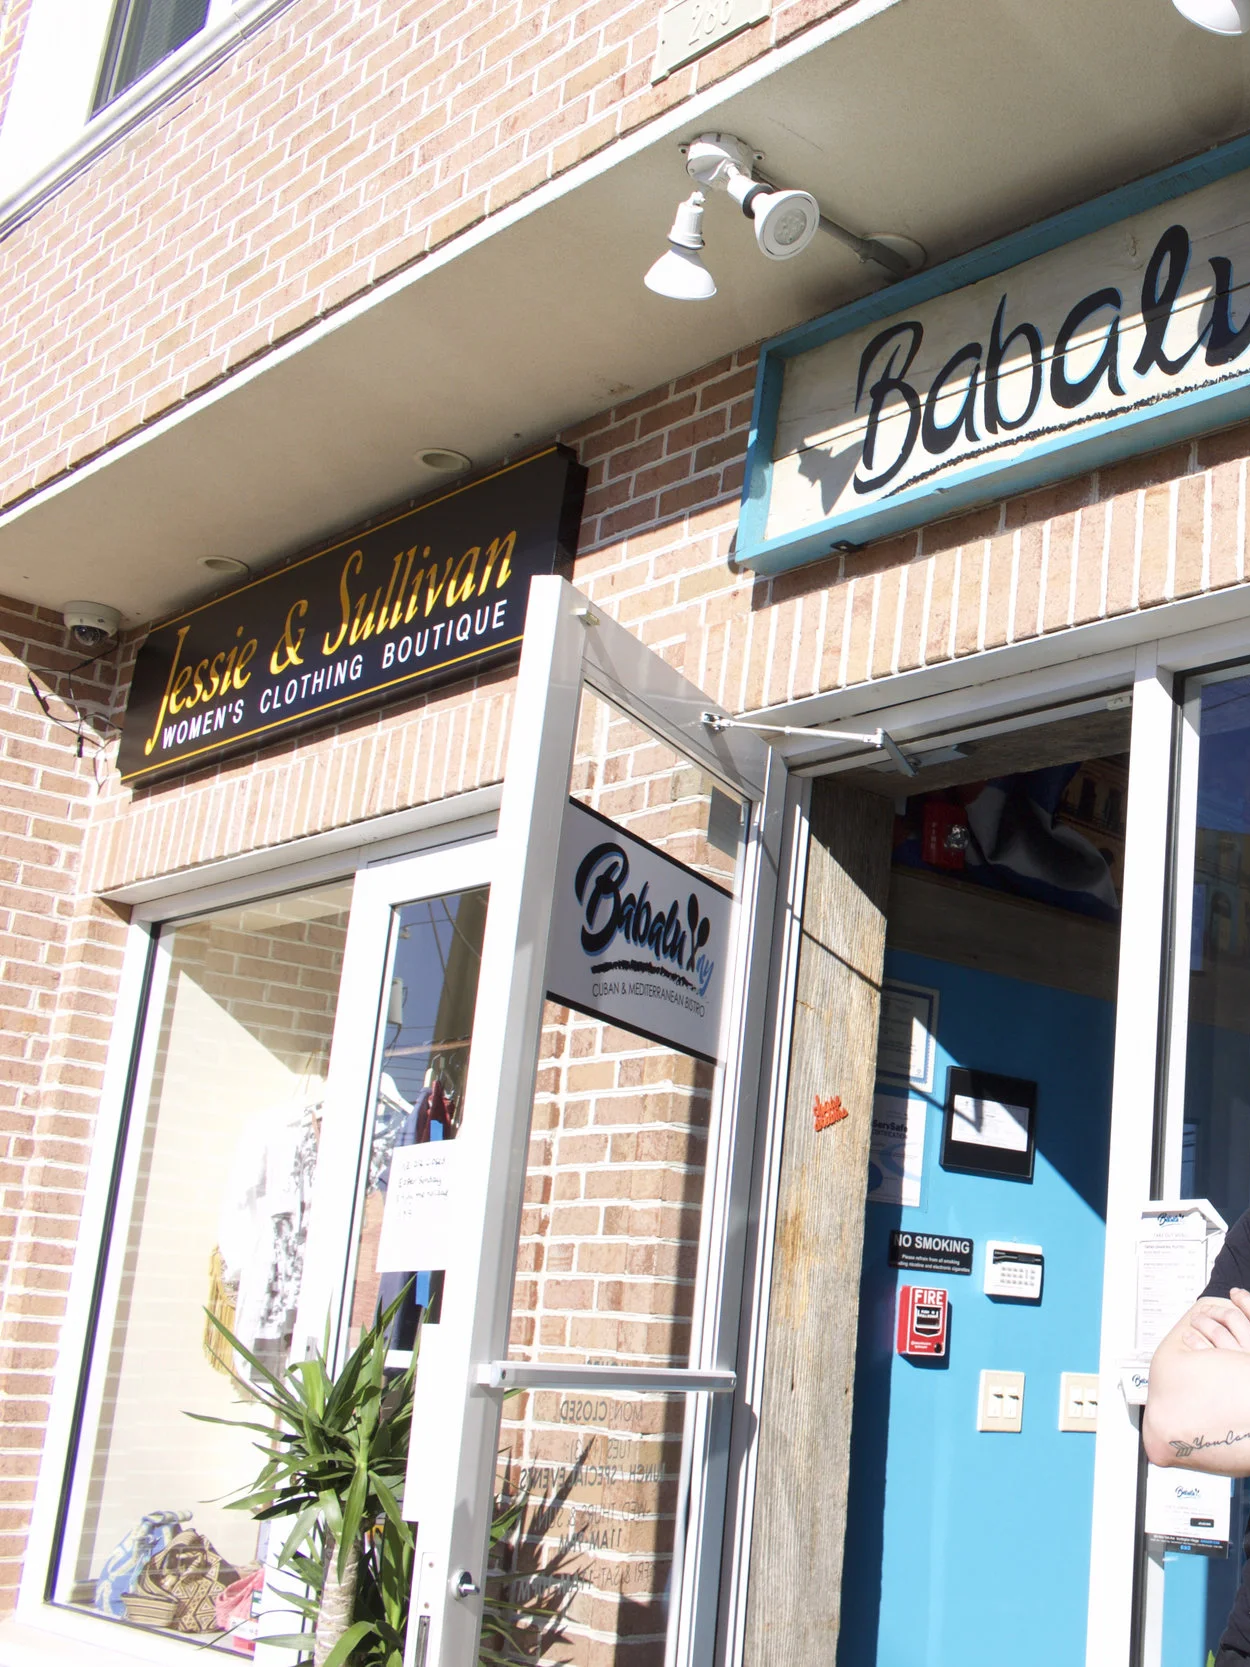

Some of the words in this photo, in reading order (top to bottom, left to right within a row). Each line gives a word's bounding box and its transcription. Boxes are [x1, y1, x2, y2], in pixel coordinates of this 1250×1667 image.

[145, 625, 258, 756] Jessie
[269, 600, 309, 675] &
[323, 530, 517, 656] Sullivan
[162, 700, 245, 749] WOMEN'S
[259, 654, 364, 715] CLOTHING
[382, 599, 507, 669] BOUTIQUE
[574, 842, 687, 971] Babalu
[592, 983, 620, 998] CUBAN
[621, 983, 627, 995] &
[628, 982, 684, 1006] MEDITERRANEAN
[684, 1000, 705, 1017] BISTRO
[894, 1234, 912, 1248] NO
[914, 1235, 970, 1254] SMOKING
[914, 1289, 944, 1305] FIRE
